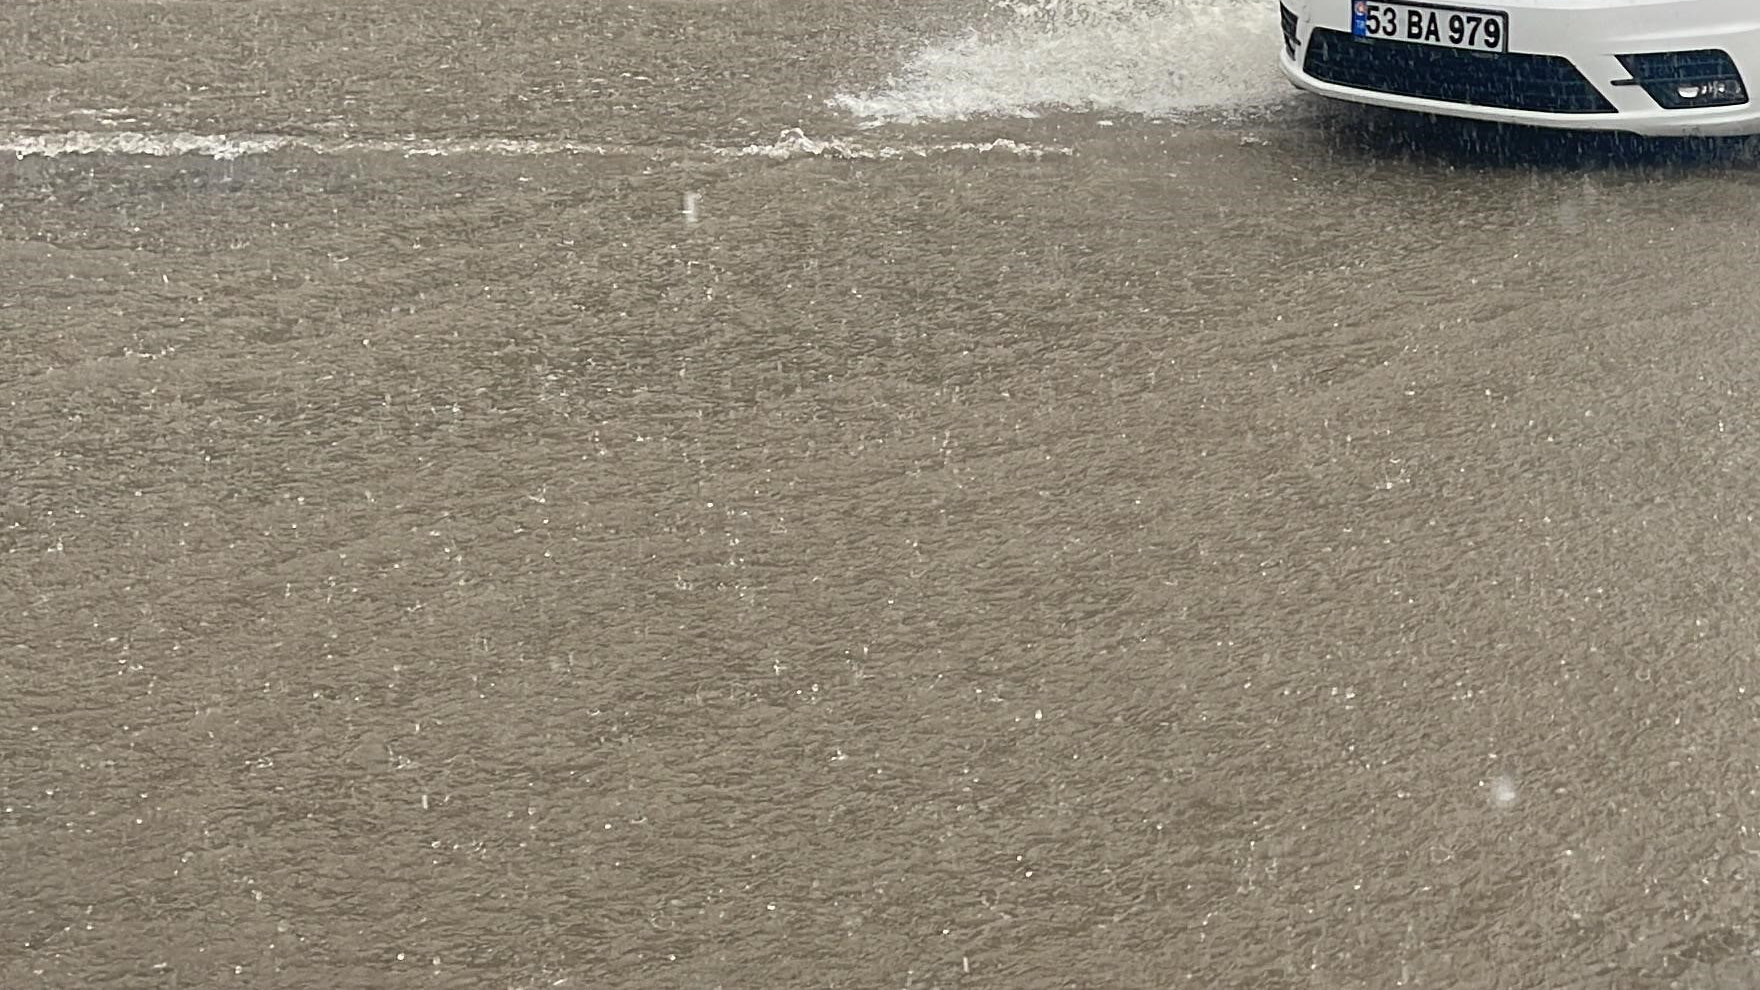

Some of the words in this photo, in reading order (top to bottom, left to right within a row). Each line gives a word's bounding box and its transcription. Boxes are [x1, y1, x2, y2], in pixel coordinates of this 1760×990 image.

[1366, 5, 1397, 36] 53
[1407, 9, 1441, 42] BA
[1449, 14, 1501, 48] 979
